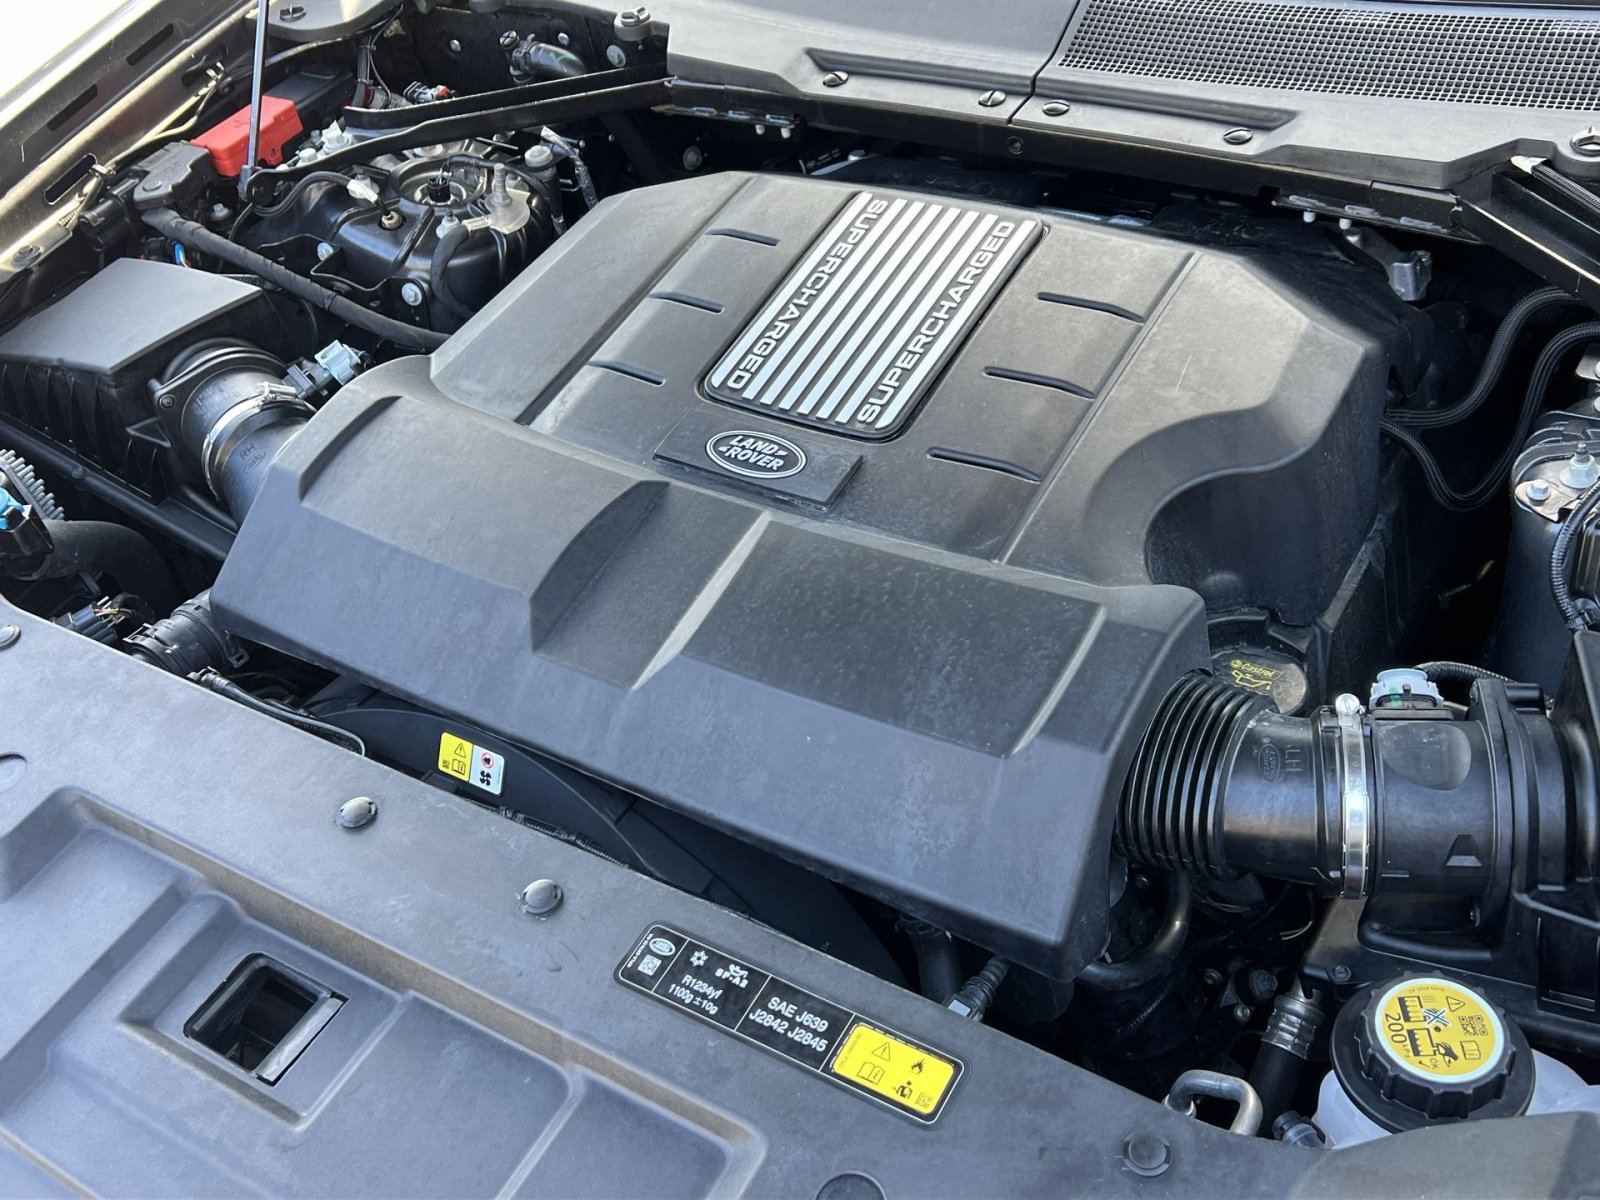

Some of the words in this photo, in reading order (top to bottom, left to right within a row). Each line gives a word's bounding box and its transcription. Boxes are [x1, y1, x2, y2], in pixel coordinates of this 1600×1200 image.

[726, 197, 889, 390] SUPERCHARGED
[857, 220, 1015, 424] SUPERCHARGED
[729, 435, 779, 455] LAND
[724, 446, 785, 471] ROVER
[1241, 663, 1276, 678] Castrol
[668, 983, 694, 1004] 1100g
[681, 974, 723, 1000] R1234yf
[767, 996, 798, 1018] SAE
[795, 1011, 829, 1032] J639
[748, 1008, 789, 1034] J2842
[787, 1026, 829, 1052] J2845
[1385, 1012, 1408, 1044] 200
[1429, 1057, 1440, 1070] OK
